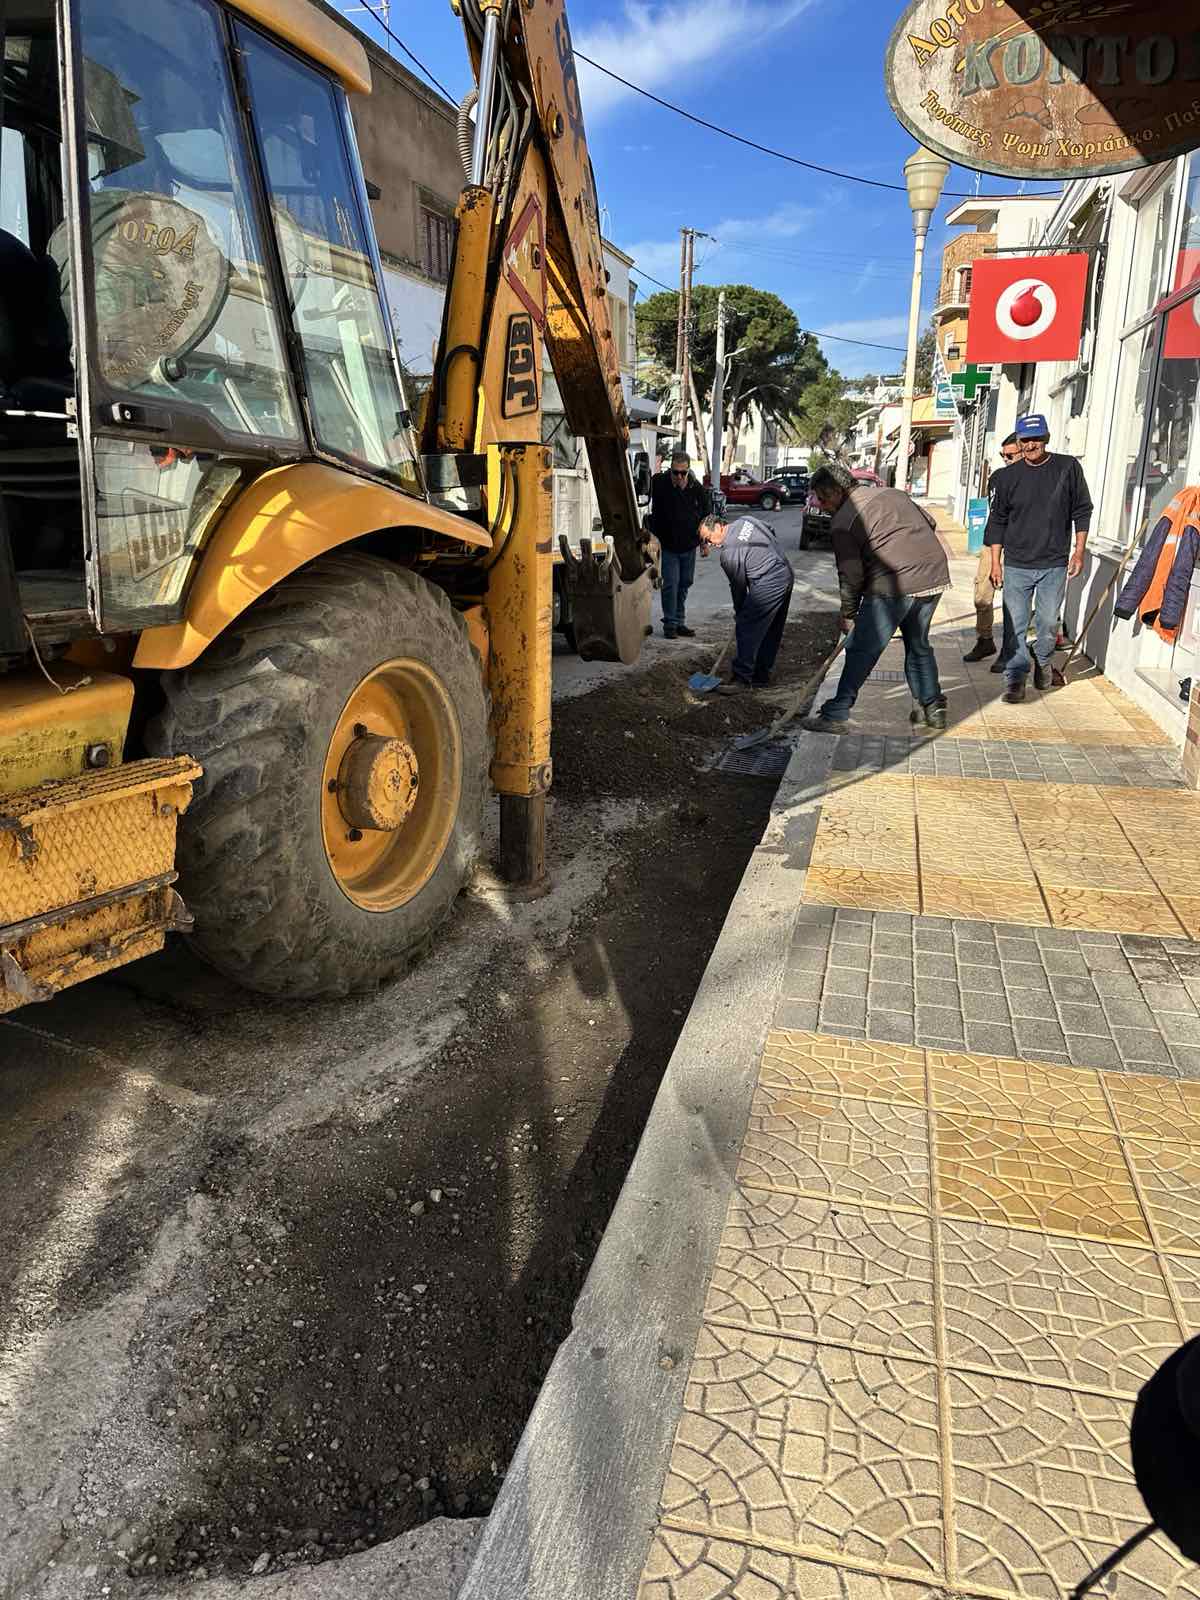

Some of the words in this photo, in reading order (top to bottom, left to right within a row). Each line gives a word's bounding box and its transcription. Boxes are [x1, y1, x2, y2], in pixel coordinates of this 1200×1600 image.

[907, 0, 1004, 68] Αρτο
[1003, 133, 1051, 159] Ψωμί
[508, 321, 536, 407] JCB
